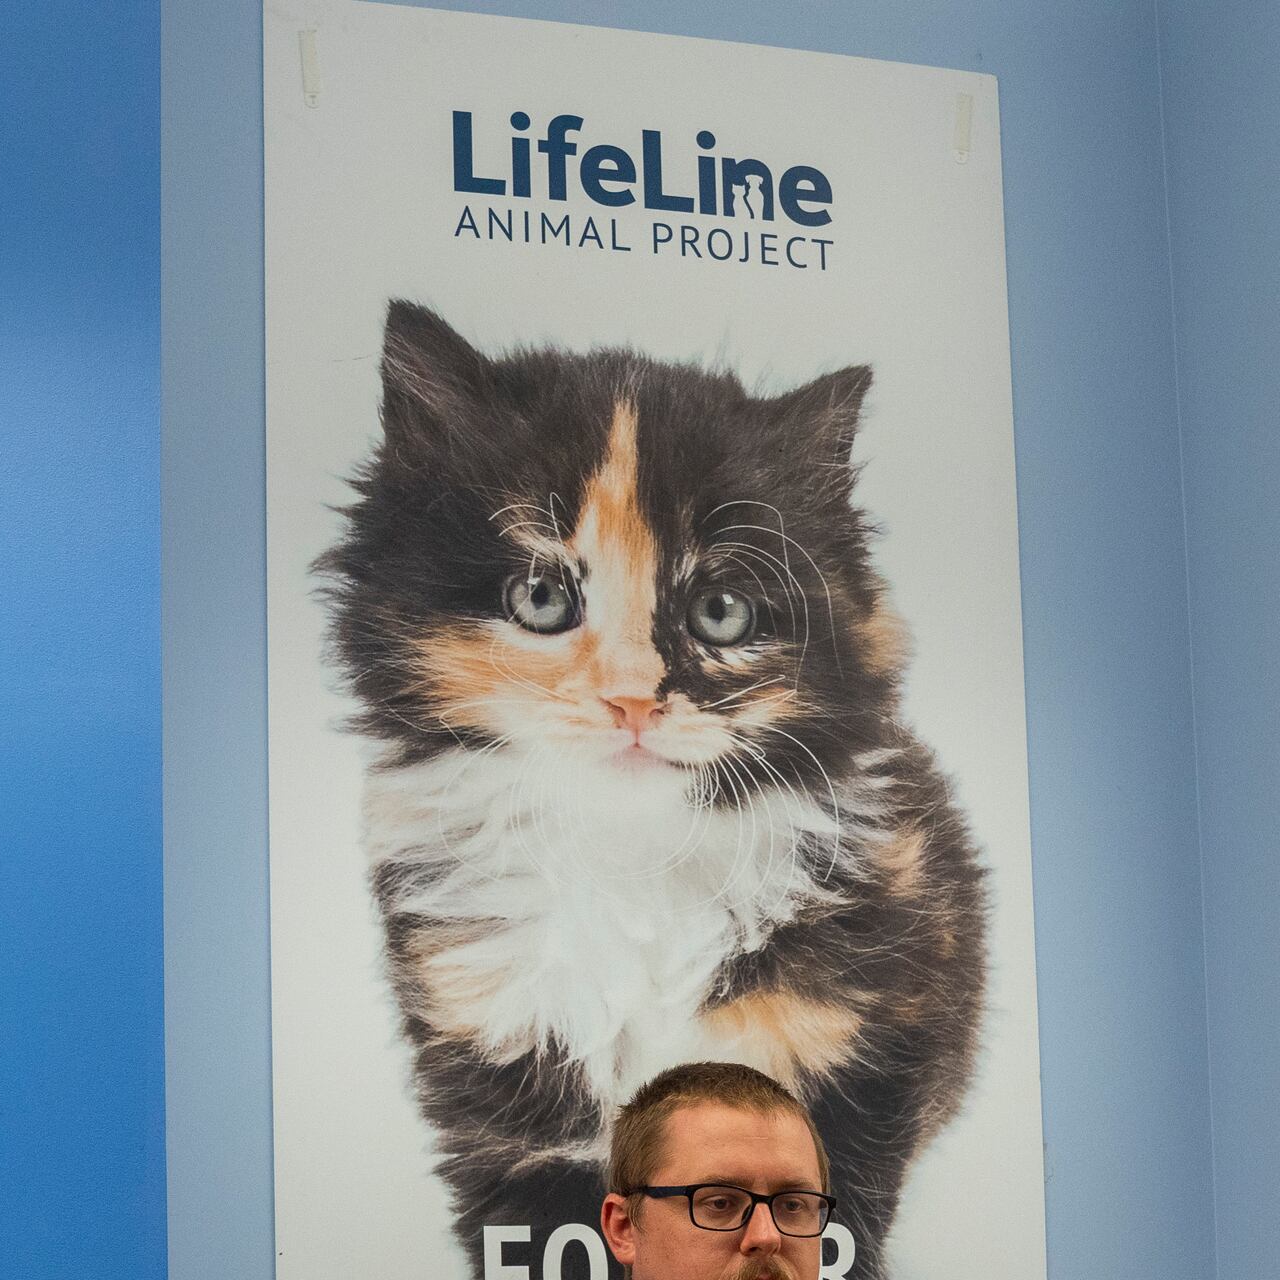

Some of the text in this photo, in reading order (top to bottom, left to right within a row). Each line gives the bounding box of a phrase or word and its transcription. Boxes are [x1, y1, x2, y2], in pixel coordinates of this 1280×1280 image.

[452, 110, 833, 227] LifeLine
[454, 205, 834, 271] ANIMAL PROJECT
